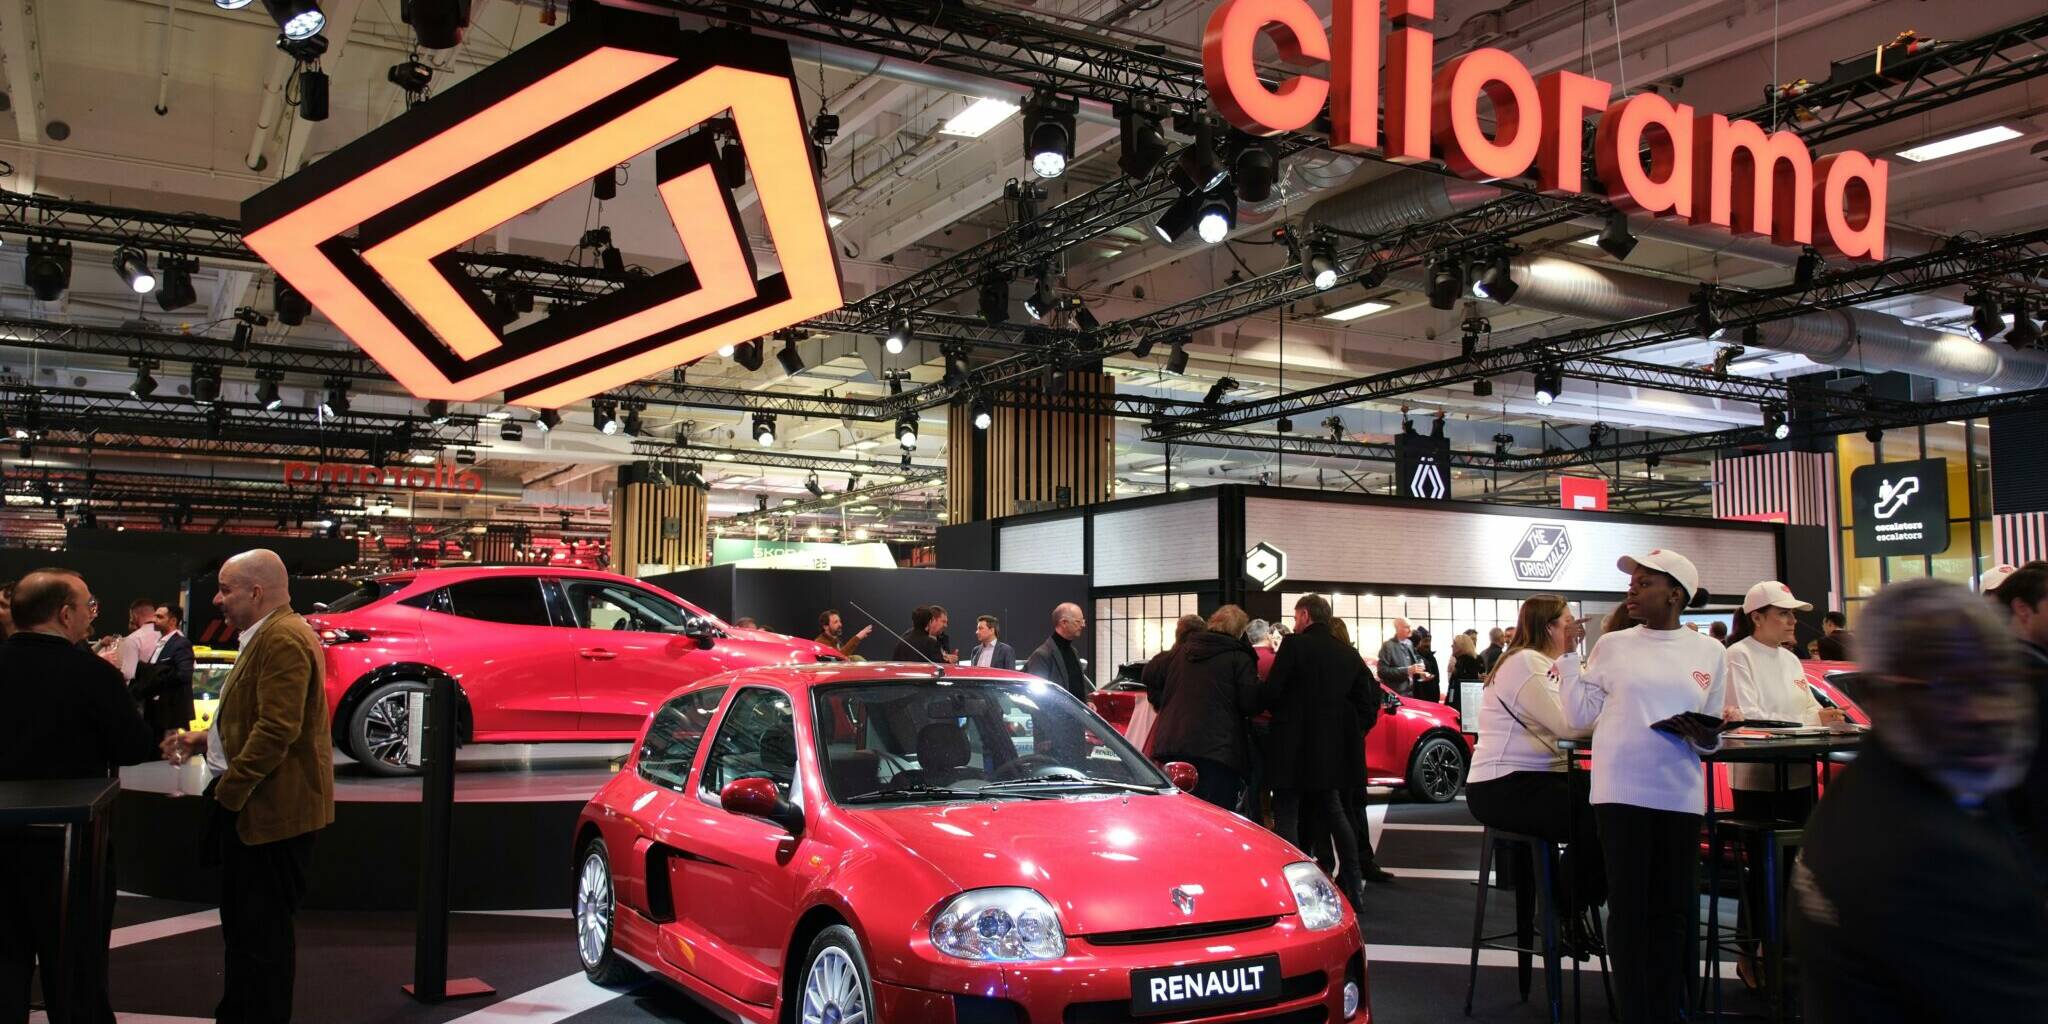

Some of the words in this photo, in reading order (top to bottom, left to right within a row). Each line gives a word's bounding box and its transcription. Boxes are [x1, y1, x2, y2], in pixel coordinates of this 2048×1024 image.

[1203, 0, 1888, 261] cliorama
[1527, 529, 1548, 551] THE
[1876, 532, 1923, 542] escalators
[1519, 537, 1567, 577] ORIGINALS
[1150, 966, 1264, 1003] RENAULT
